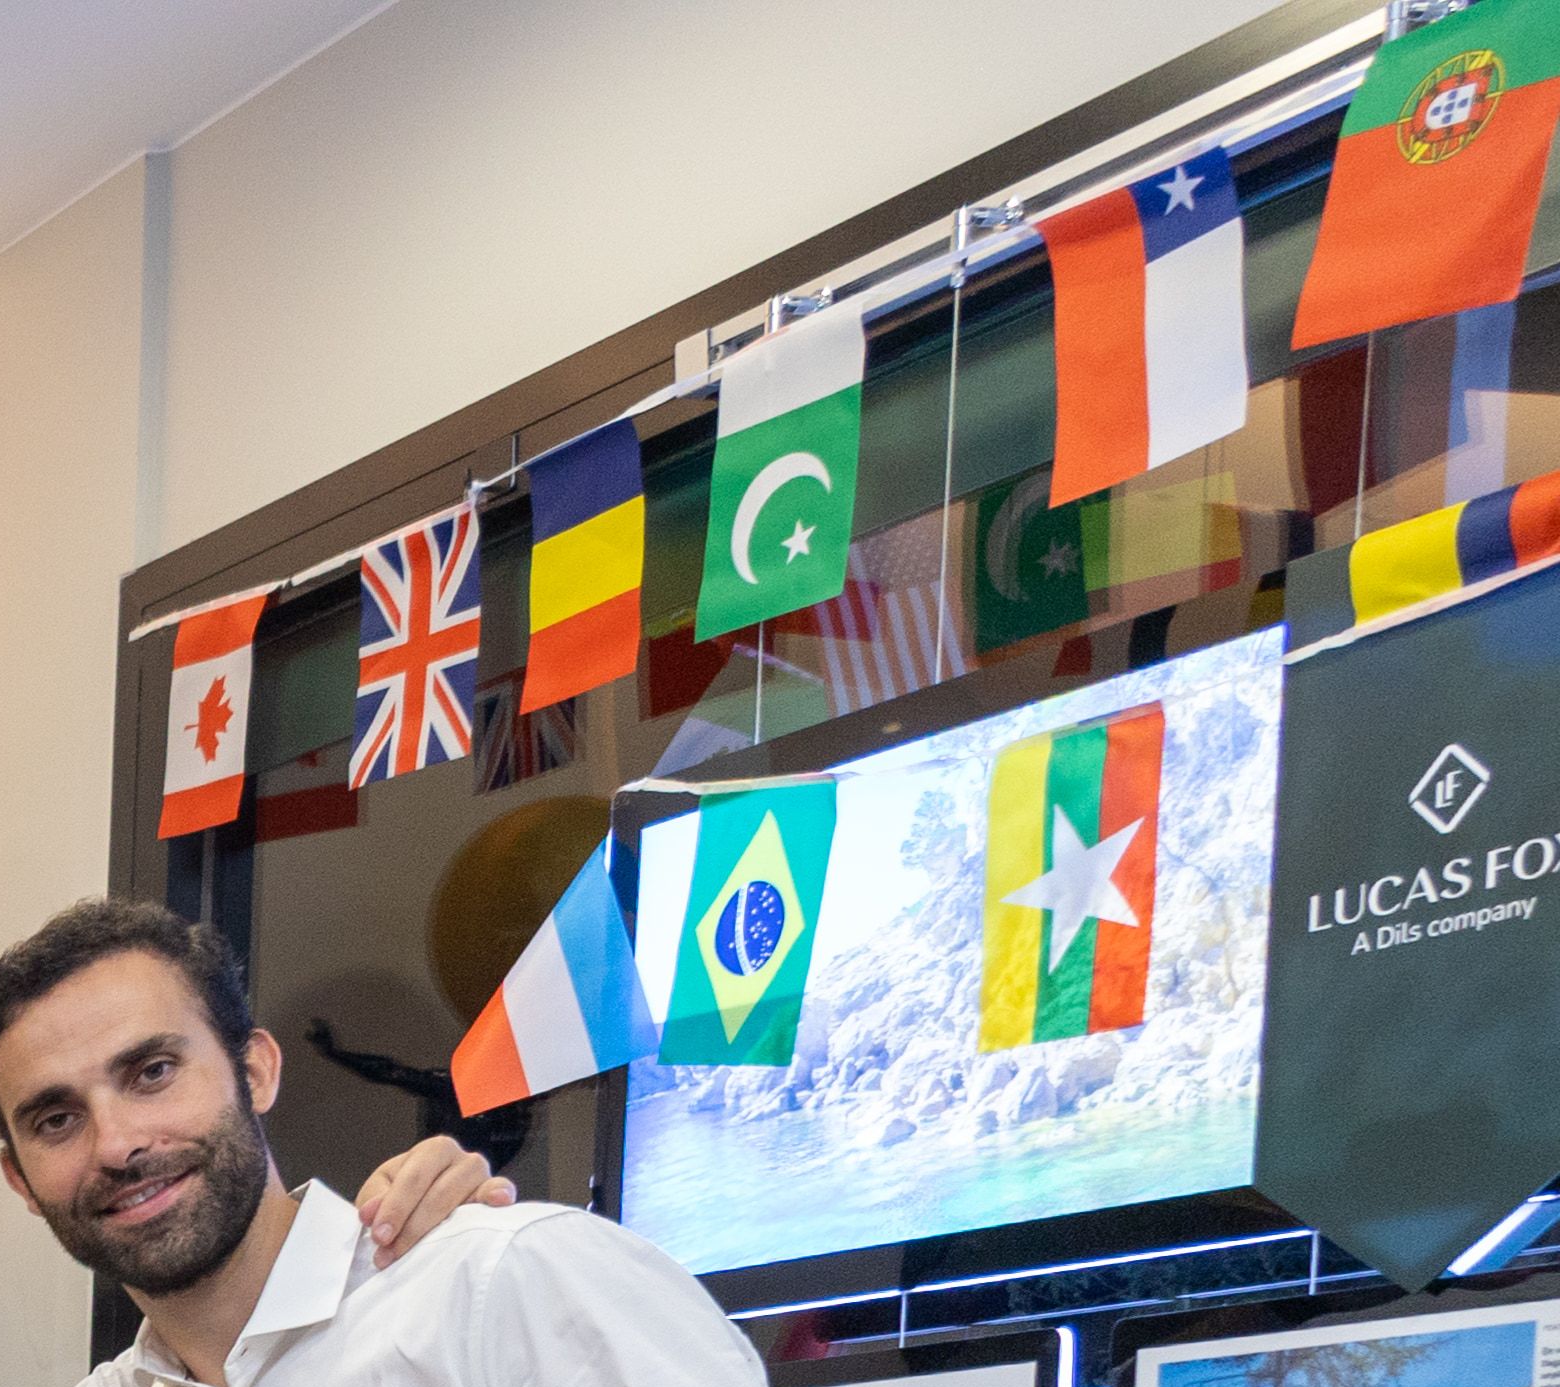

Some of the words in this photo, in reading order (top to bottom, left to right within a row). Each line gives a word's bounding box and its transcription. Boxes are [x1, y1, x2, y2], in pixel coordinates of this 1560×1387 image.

[1308, 857, 1473, 933] LUCAS
[1484, 833, 1560, 889] FO
[1351, 932, 1371, 956] A
[1376, 922, 1421, 950] Dils
[1426, 896, 1538, 931] company
